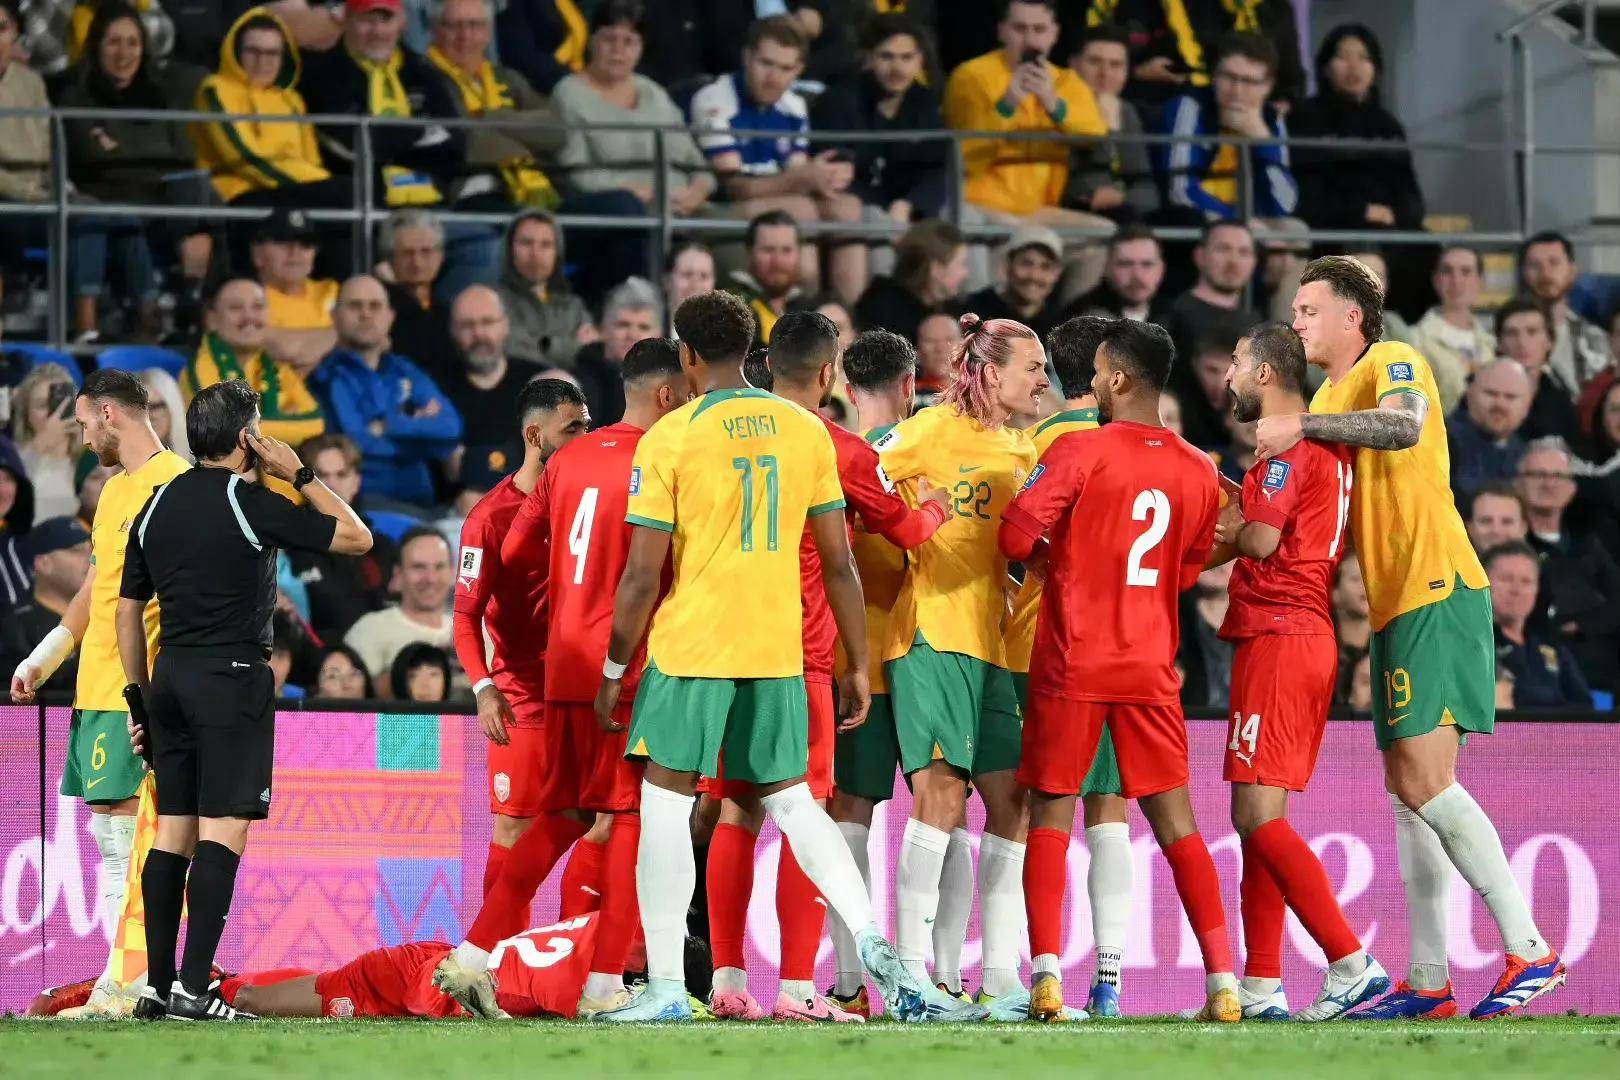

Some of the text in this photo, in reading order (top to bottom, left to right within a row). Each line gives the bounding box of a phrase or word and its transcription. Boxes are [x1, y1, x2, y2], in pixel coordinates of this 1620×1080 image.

[722, 414, 777, 440] YENGI
[732, 454, 779, 552] 11
[953, 480, 992, 520] 22
[568, 487, 599, 585] 4
[1126, 487, 1171, 587] 2
[1384, 667, 1411, 709] 19
[91, 732, 106, 771] 6
[1228, 711, 1261, 753] 14
